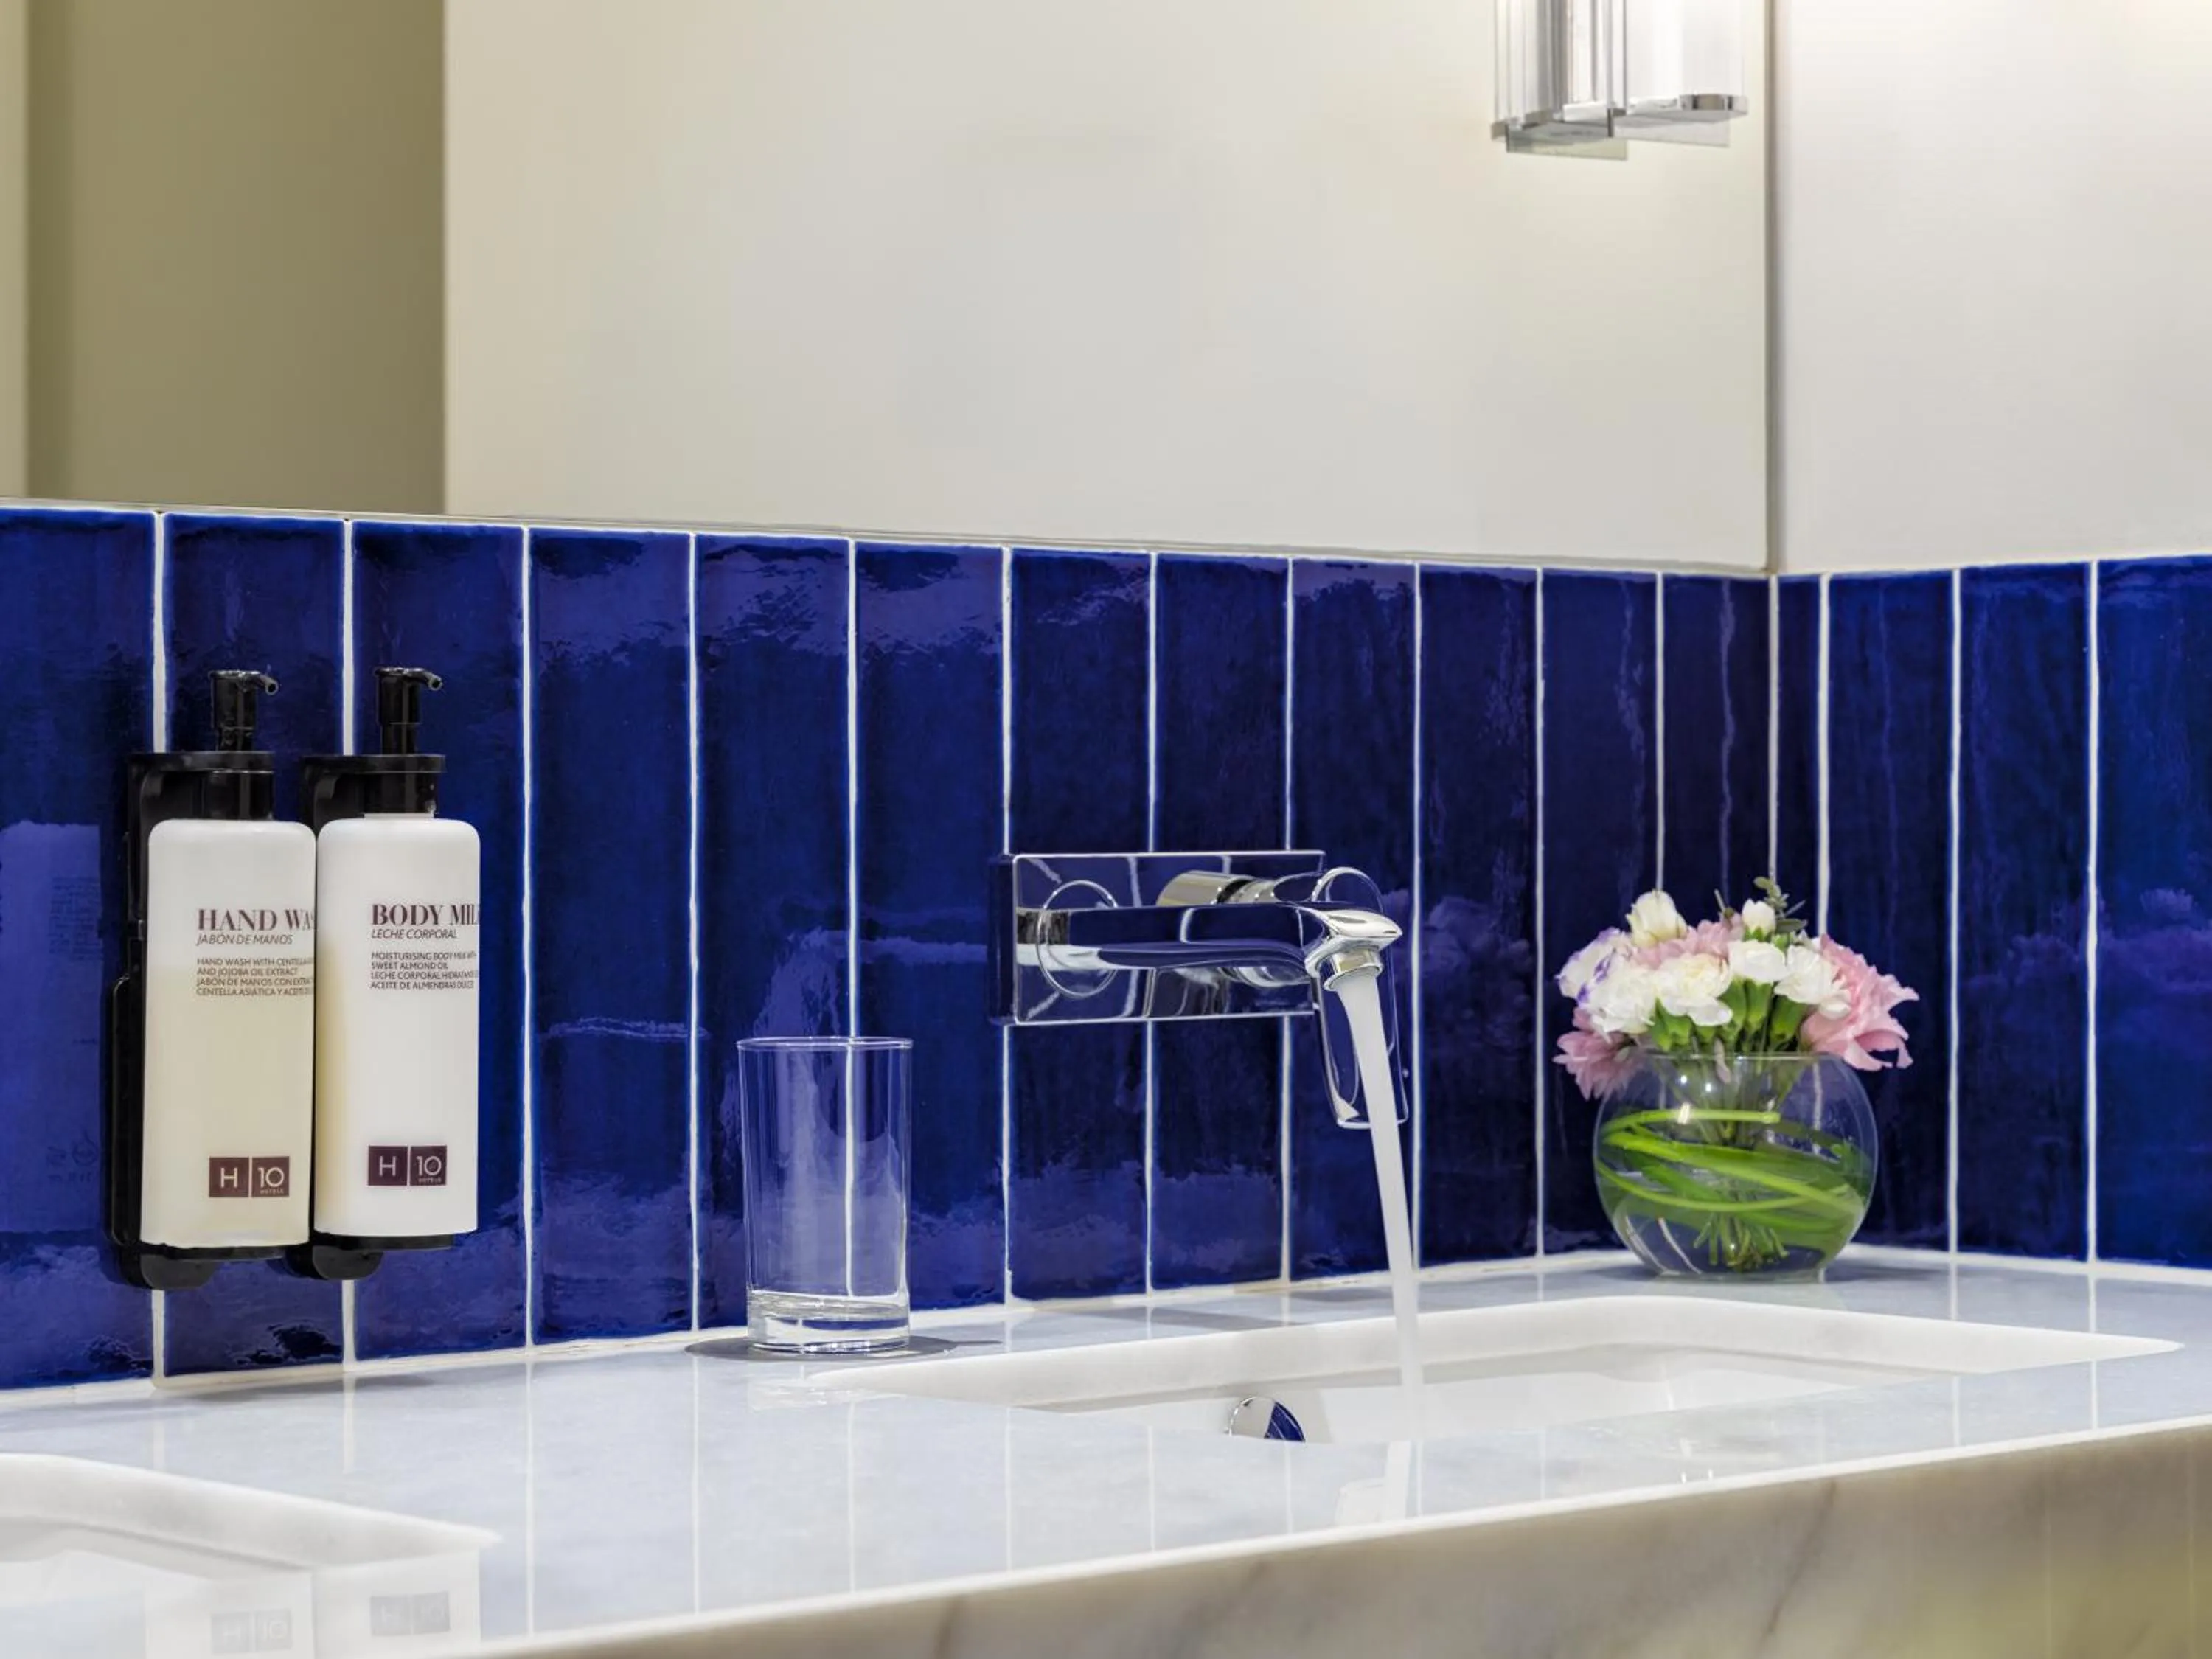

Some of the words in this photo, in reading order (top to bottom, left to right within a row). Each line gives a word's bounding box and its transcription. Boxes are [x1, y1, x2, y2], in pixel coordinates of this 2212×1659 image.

[372, 904, 444, 925] BODY
[198, 908, 277, 931] HAND
[371, 928, 404, 939] LECHE
[406, 928, 457, 939] CORPORAL
[196, 932, 235, 946] JABÓN
[236, 934, 251, 945] DE
[253, 934, 293, 945] MANOS
[371, 952, 431, 960] MOISTURISING
[433, 952, 451, 960] BODY
[197, 958, 223, 966] HAND
[225, 958, 251, 966] WASH
[253, 958, 275, 966] WITH
[371, 961, 398, 970] SWEET
[399, 961, 436, 970] ALMOND
[197, 967, 216, 975] AND
[266, 967, 298, 975] EXTRACT
[371, 971, 396, 980] LECHE
[397, 971, 442, 980] CORPORAL
[226, 978, 238, 986] DE
[240, 978, 272, 986] MANOS
[370, 981, 398, 990] ACEITE
[399, 981, 411, 990] DE
[196, 987, 237, 995] CENTELLA
[379, 1155, 397, 1177] H
[416, 1155, 442, 1176] 10
[220, 1167, 238, 1188] H
[257, 1167, 285, 1188] 10
